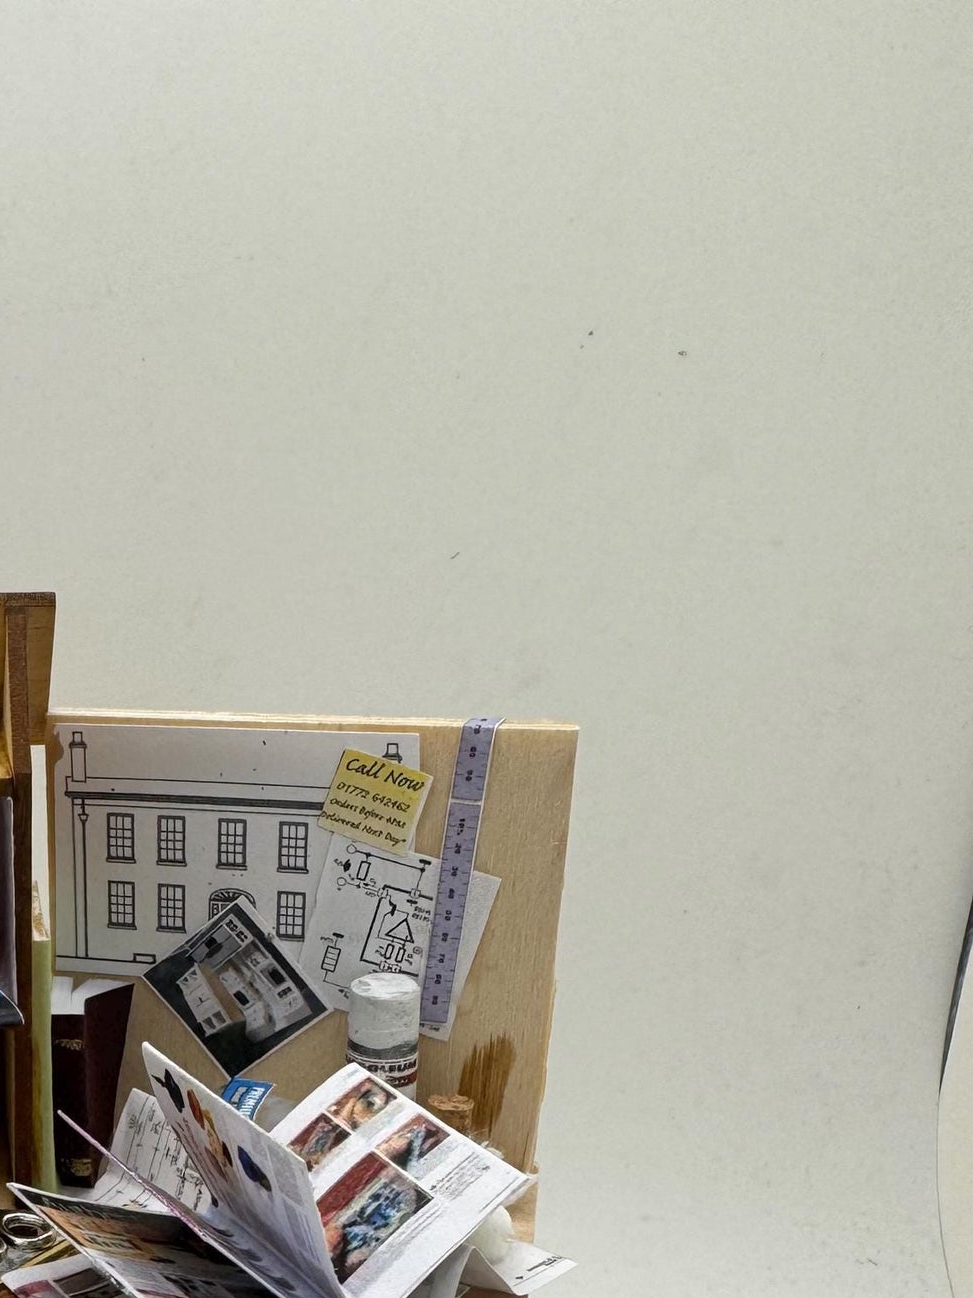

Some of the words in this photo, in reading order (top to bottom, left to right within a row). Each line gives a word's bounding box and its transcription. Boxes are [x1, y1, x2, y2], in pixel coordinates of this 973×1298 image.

[345, 758, 386, 779] Call
[383, 770, 425, 791] Now
[336, 781, 370, 799] 01772
